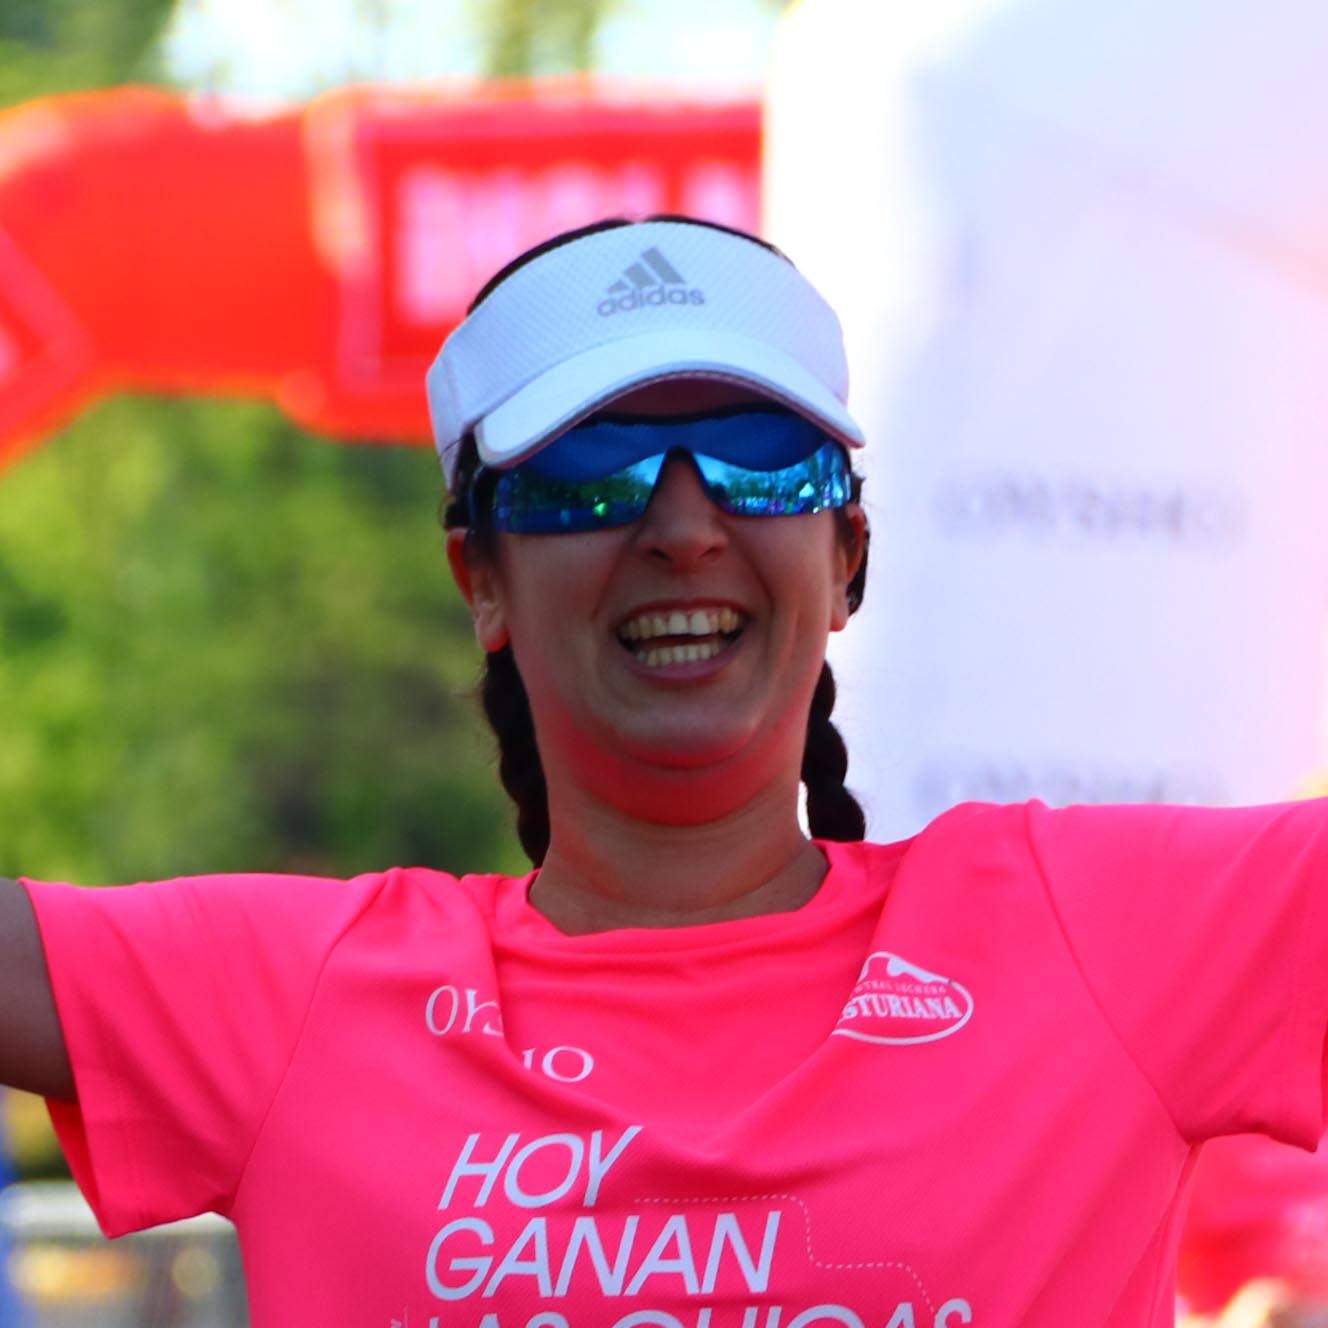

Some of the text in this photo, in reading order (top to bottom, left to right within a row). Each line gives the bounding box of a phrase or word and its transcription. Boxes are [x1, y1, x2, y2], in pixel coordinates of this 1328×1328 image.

[596, 285, 705, 317] adidas
[438, 1126, 643, 1210] HOY
[425, 1210, 782, 1301] GANAN
